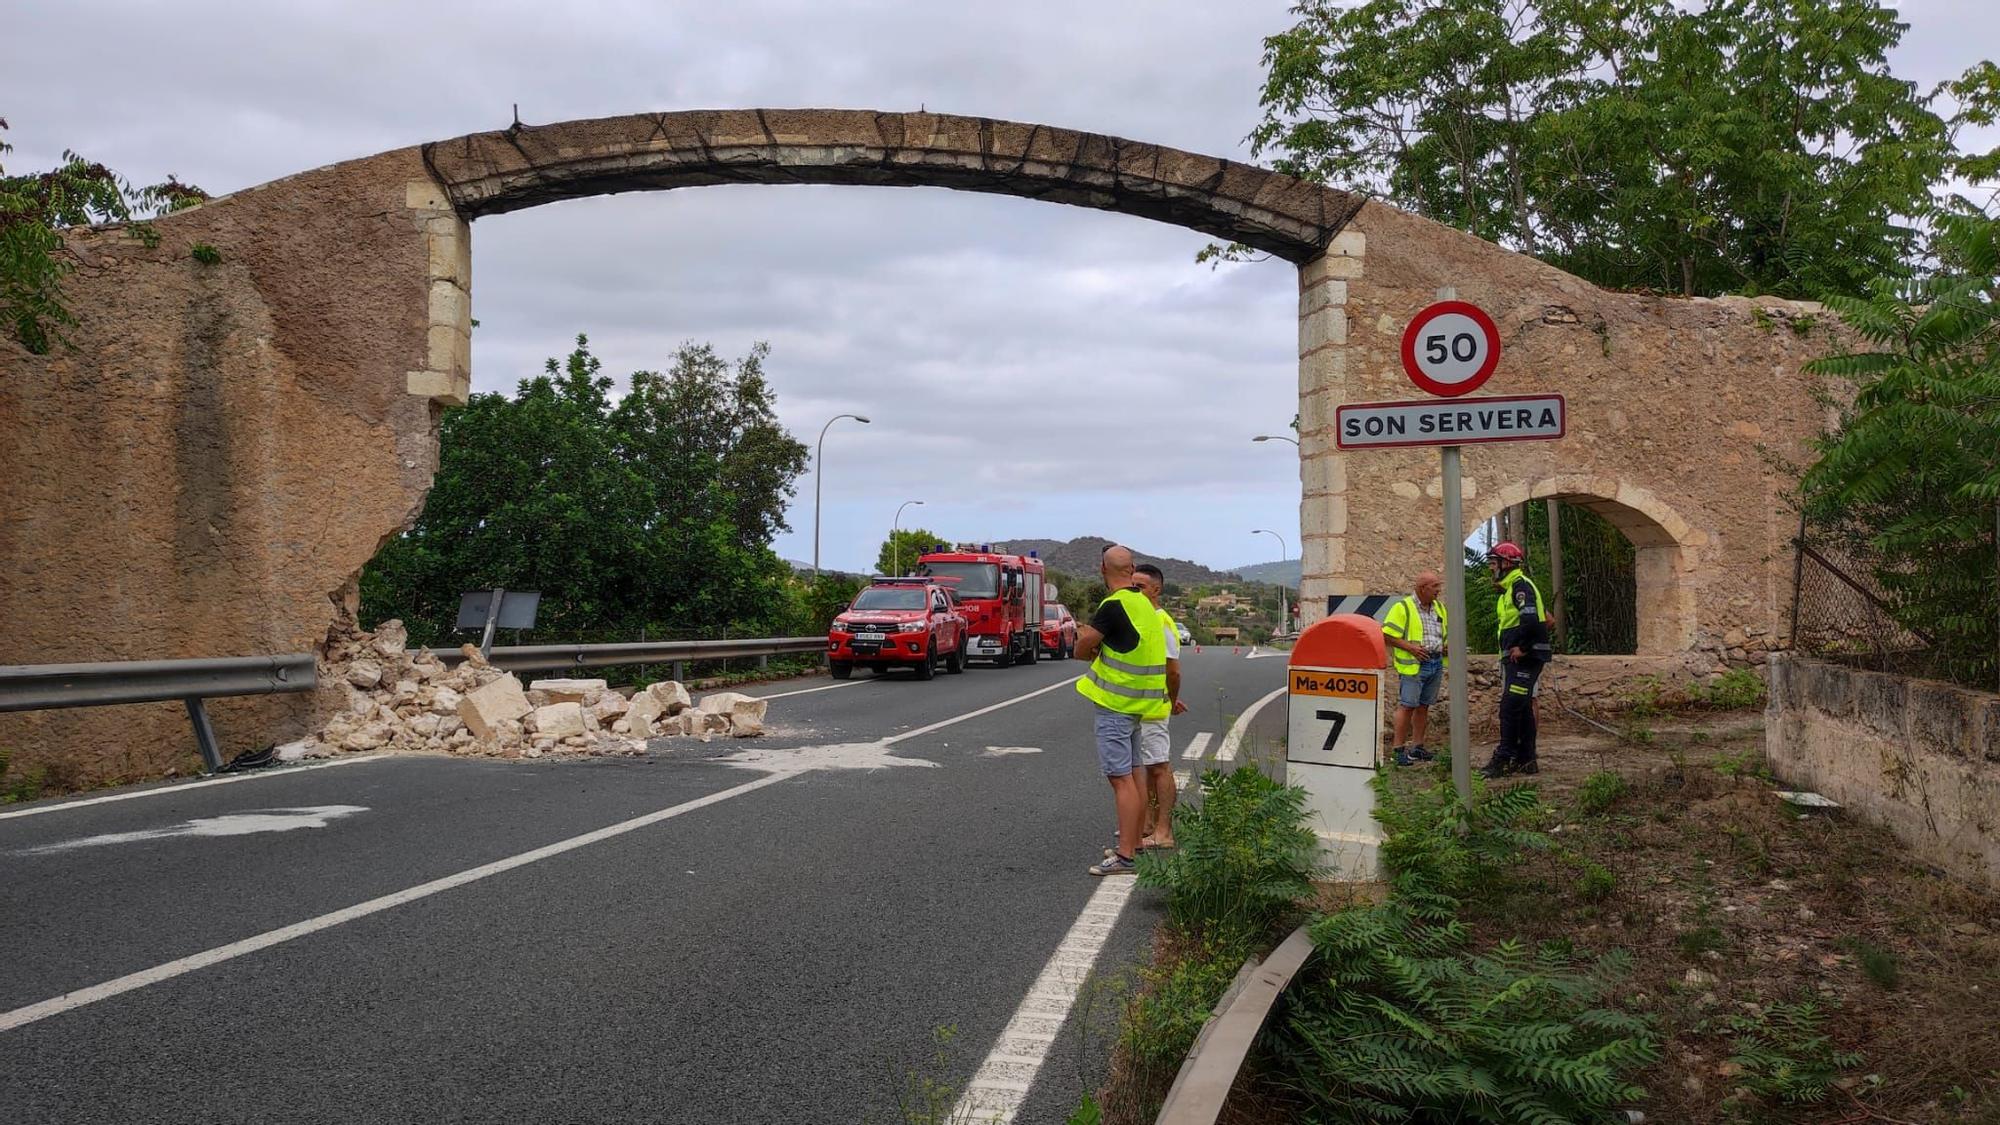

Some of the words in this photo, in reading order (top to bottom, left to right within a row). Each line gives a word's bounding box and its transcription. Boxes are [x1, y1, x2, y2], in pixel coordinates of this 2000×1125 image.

[1426, 333, 1477, 364] 50
[1345, 415, 1405, 437] SON
[1418, 408, 1557, 433] SERVERA
[1296, 676, 1369, 694] Ma-4030
[1316, 710, 1346, 750] 7
